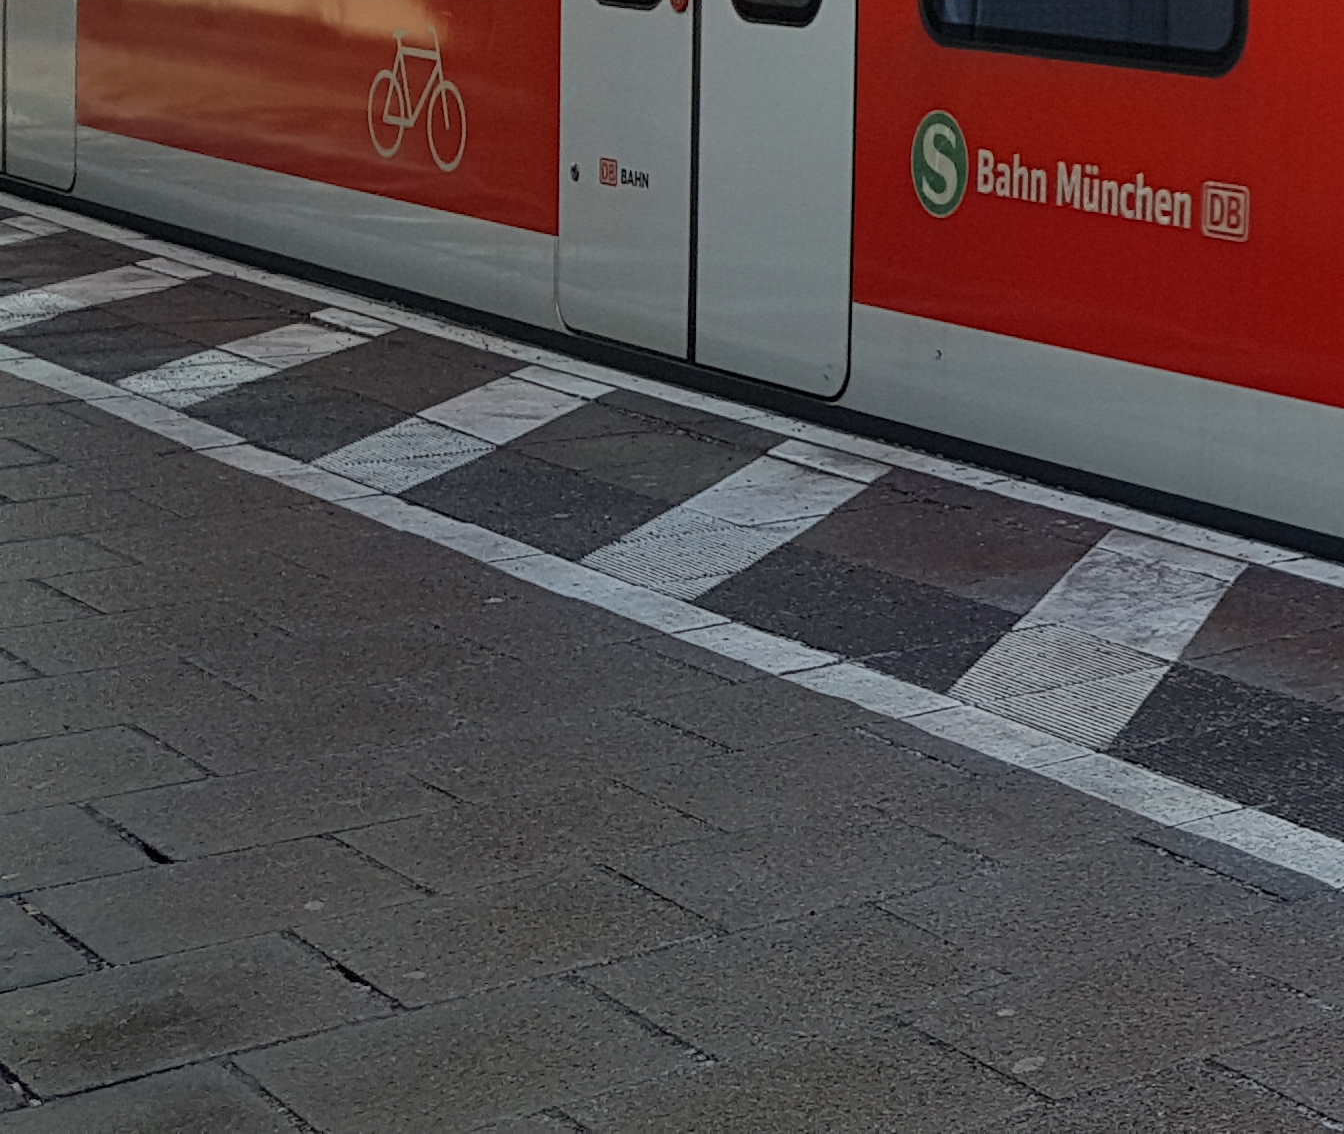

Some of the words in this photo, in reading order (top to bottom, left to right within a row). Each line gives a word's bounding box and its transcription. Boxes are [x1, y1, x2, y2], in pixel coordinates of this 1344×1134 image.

[620, 168, 649, 188] BAHN
[921, 122, 959, 206] S
[976, 147, 1047, 205] Bahn
[1055, 160, 1193, 230] München
